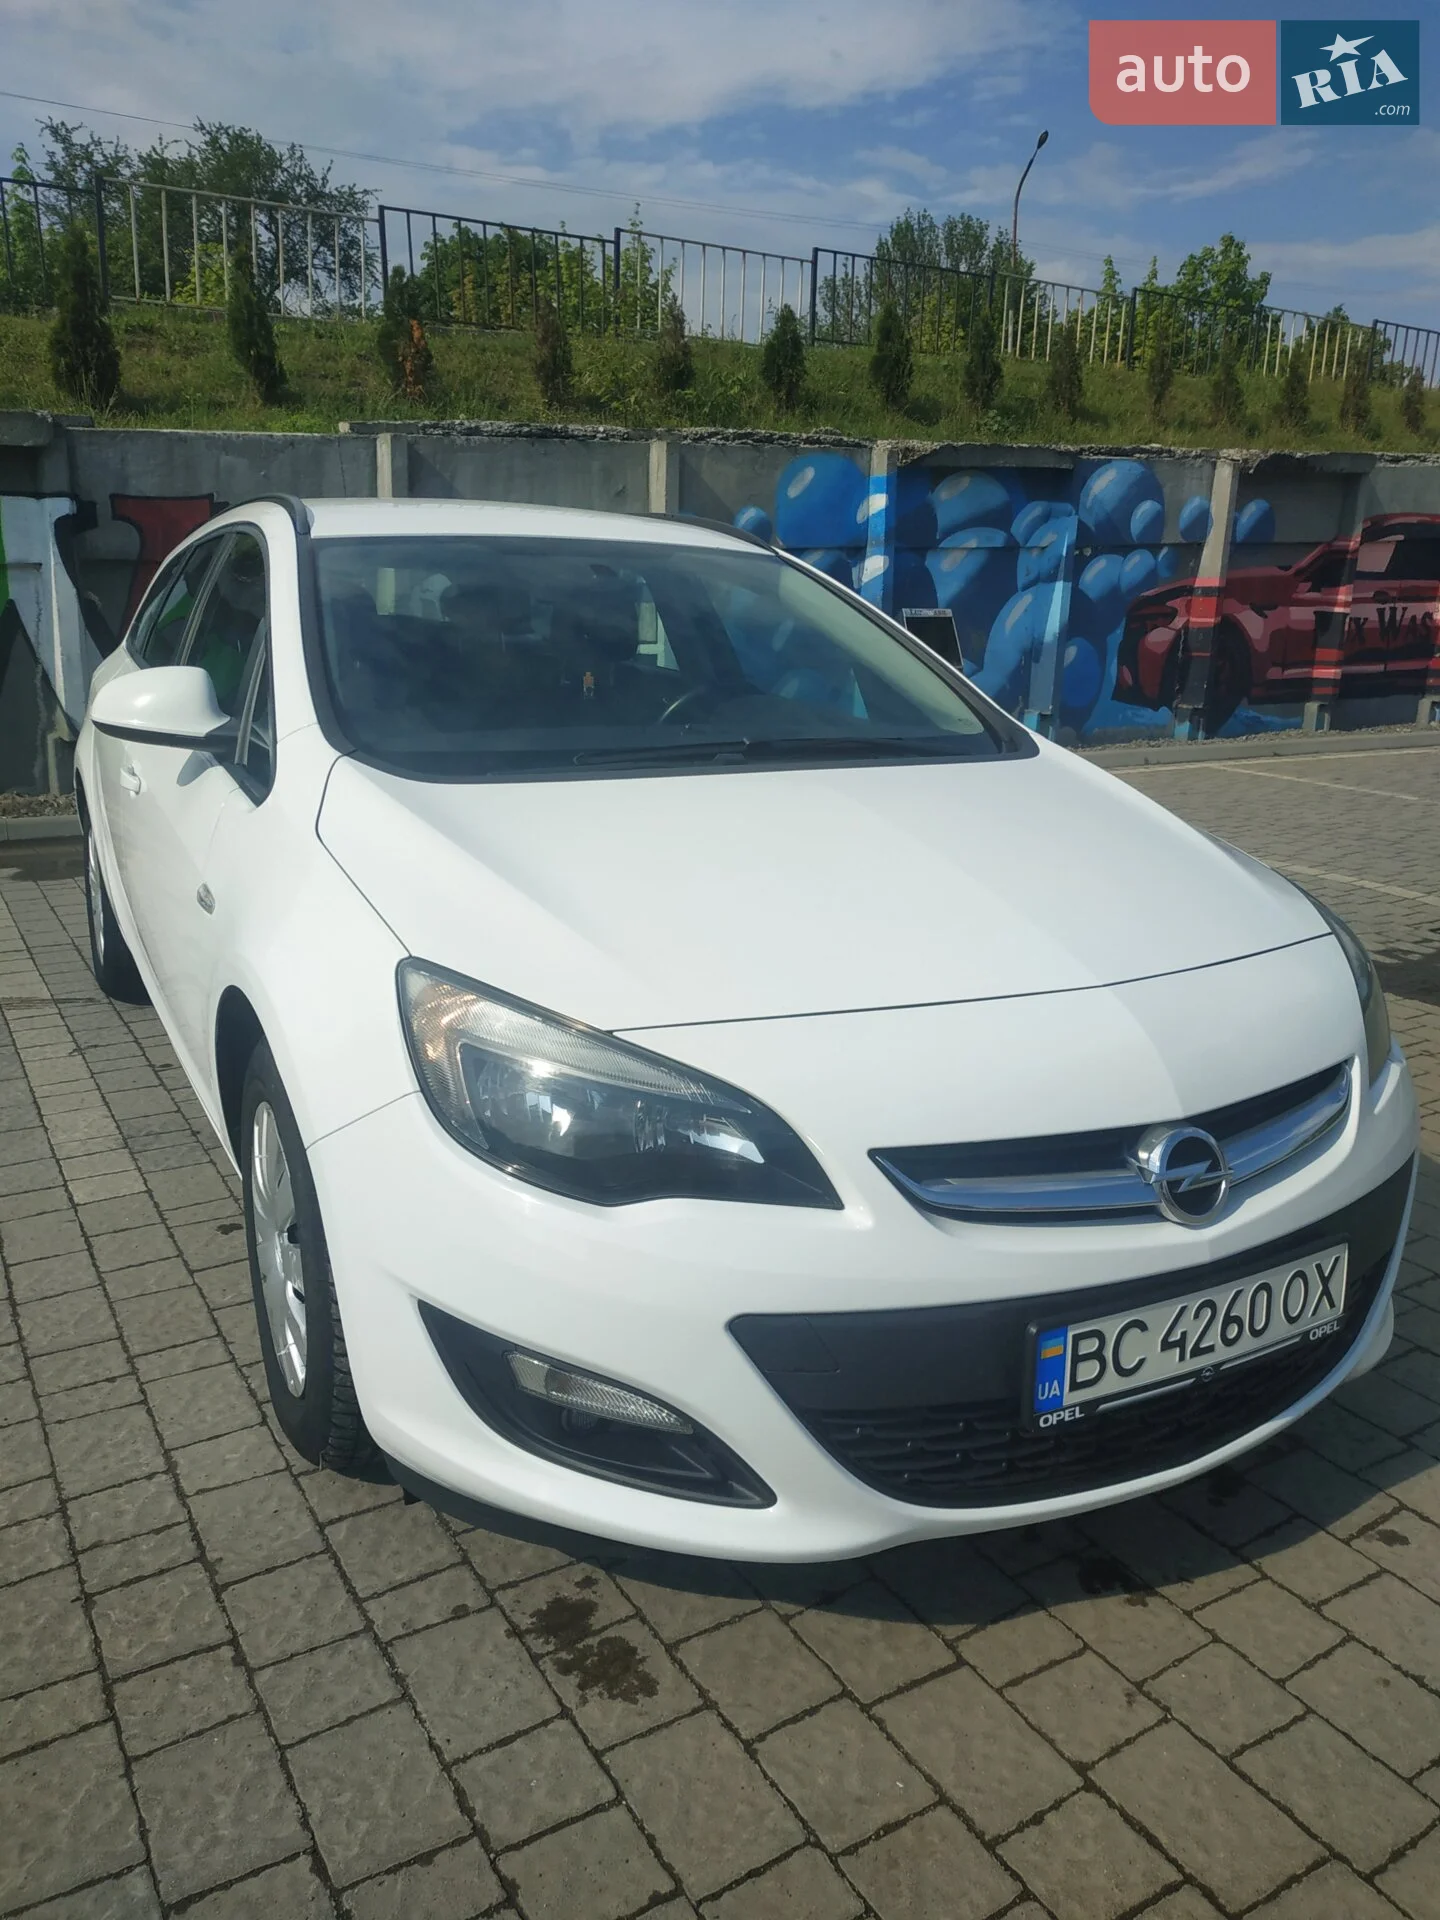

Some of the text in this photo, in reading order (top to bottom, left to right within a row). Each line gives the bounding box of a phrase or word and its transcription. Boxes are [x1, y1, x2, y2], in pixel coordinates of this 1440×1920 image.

[1068, 1254, 1341, 1393] BC 4260 OX
[1309, 1320, 1341, 1342] OPEL
[1037, 1382, 1061, 1401] UA
[1039, 1405, 1086, 1429] OPEL
